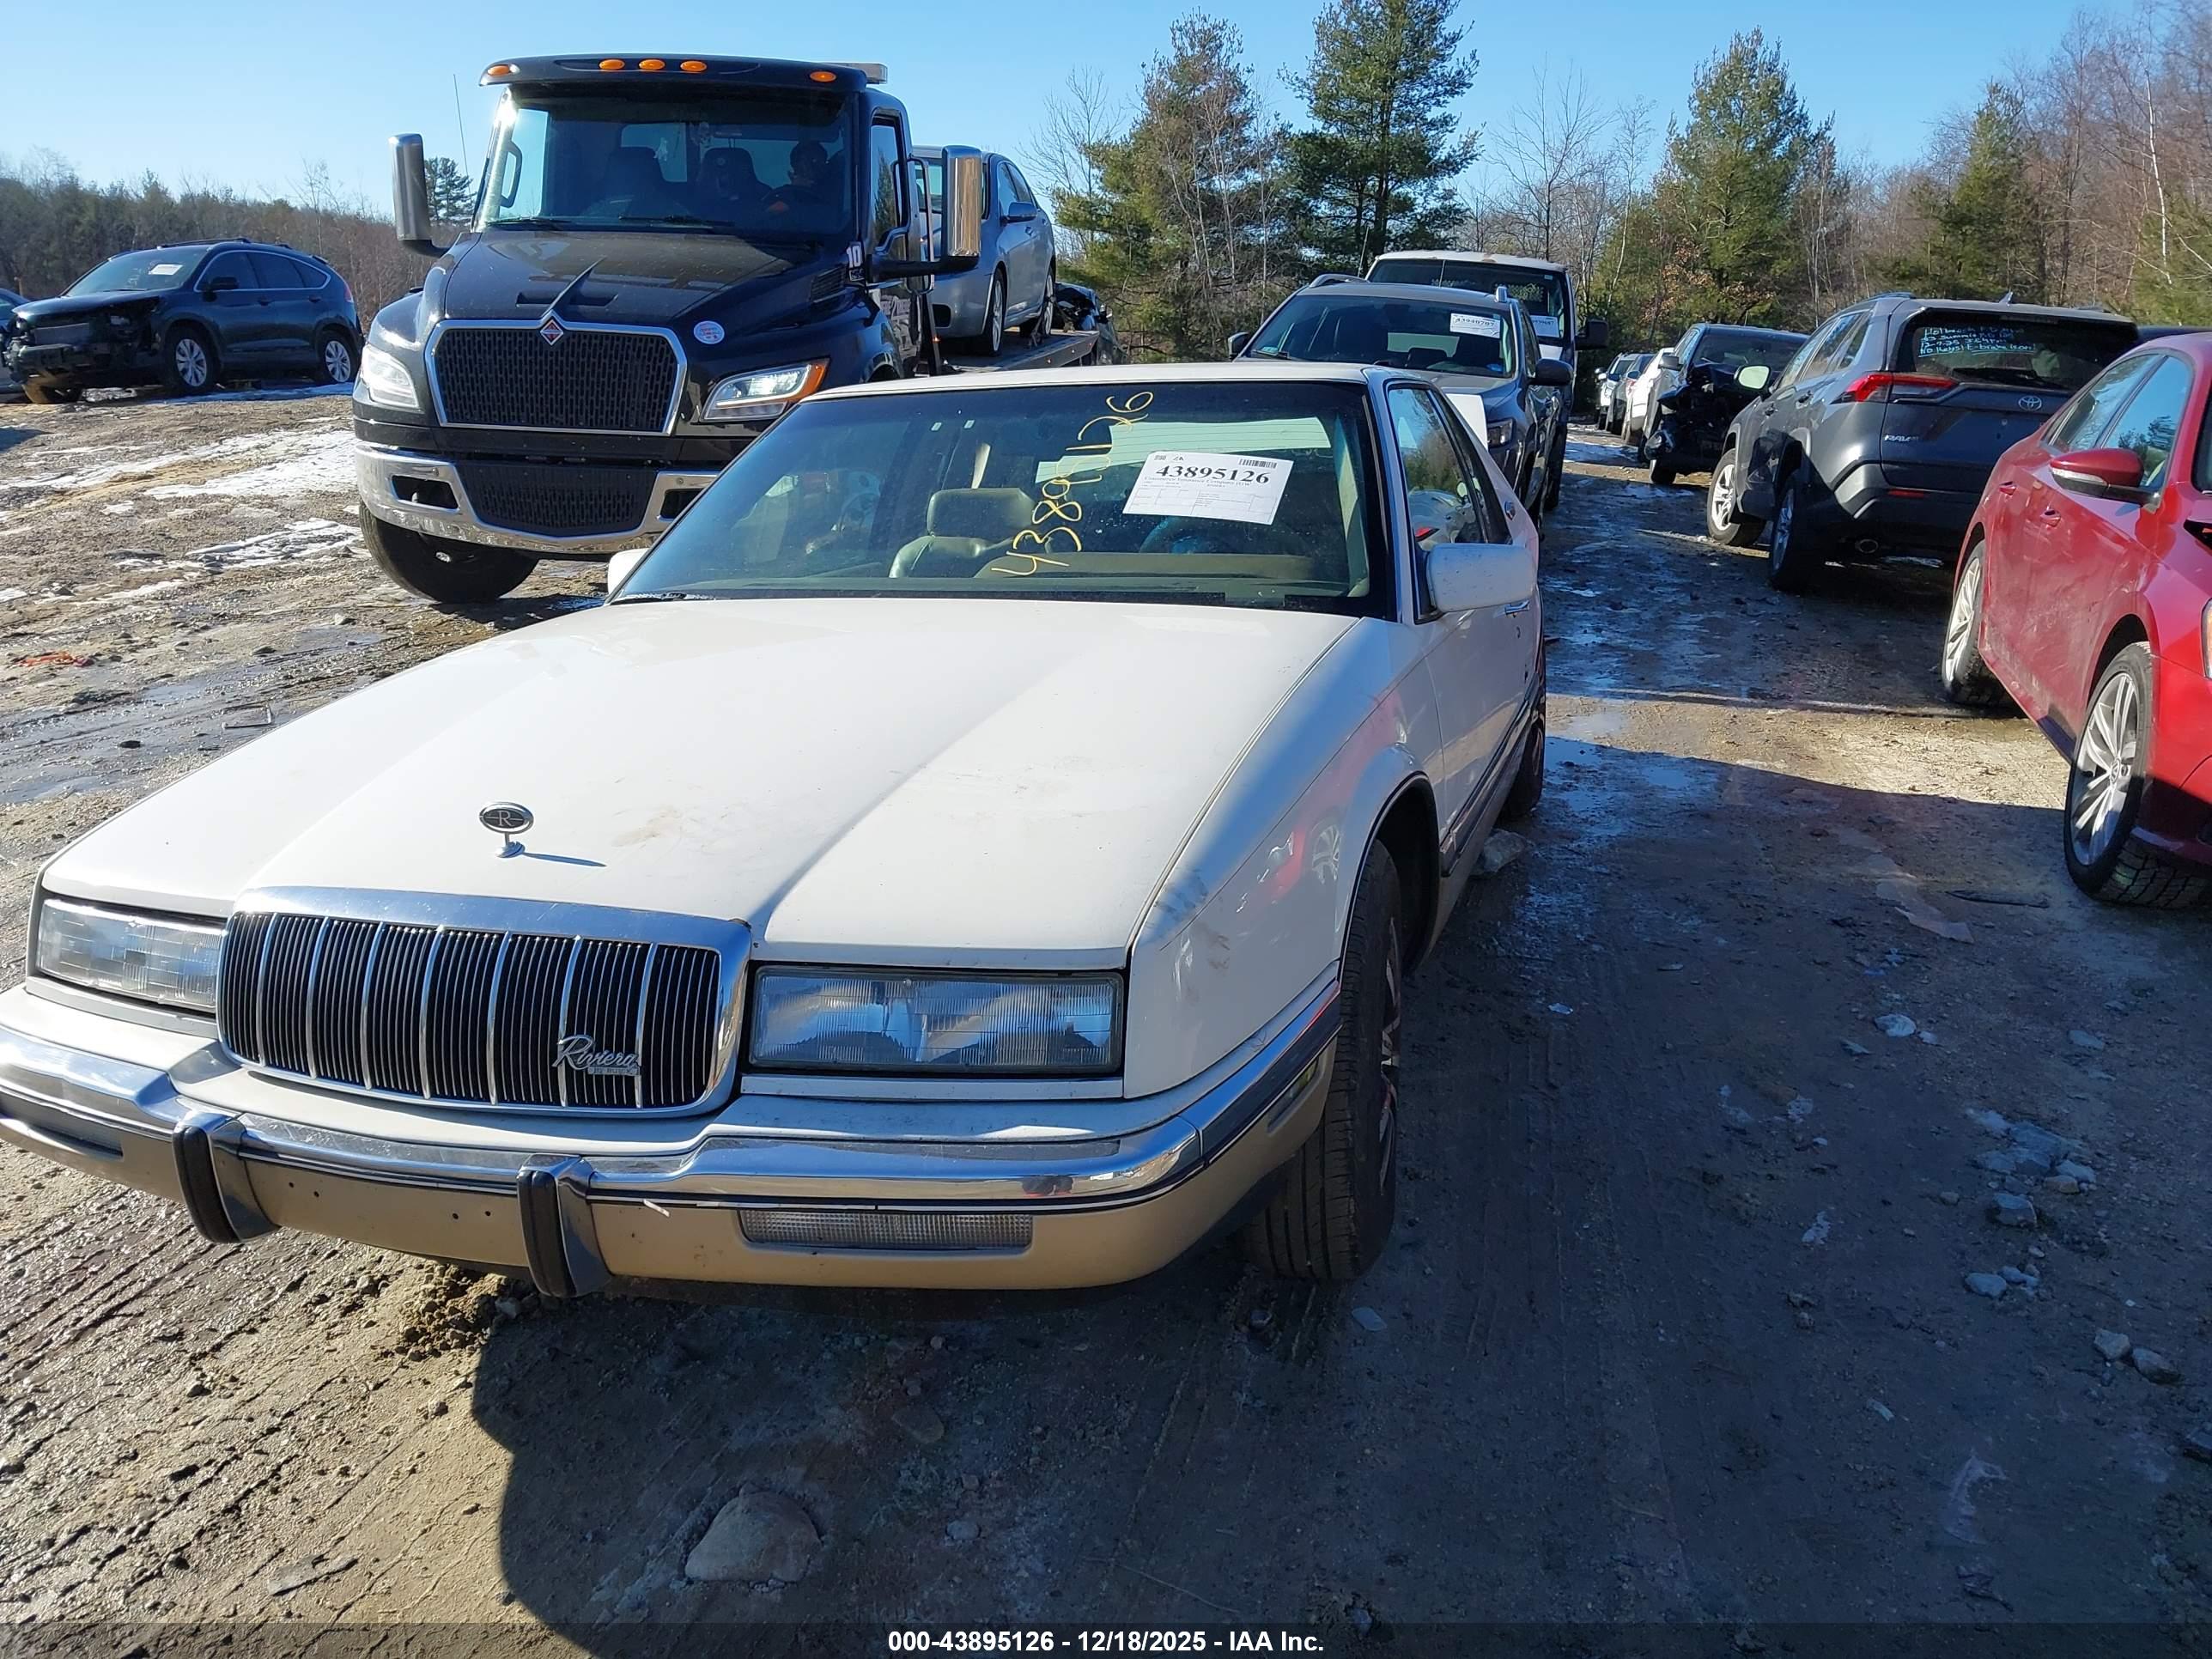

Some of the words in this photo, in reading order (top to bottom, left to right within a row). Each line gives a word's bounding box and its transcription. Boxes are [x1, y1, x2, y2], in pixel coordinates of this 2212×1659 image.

[846, 245, 862, 268] 10
[1156, 465, 1271, 484] 43895126
[497, 810, 516, 827] R
[551, 1035, 640, 1071] Riviera
